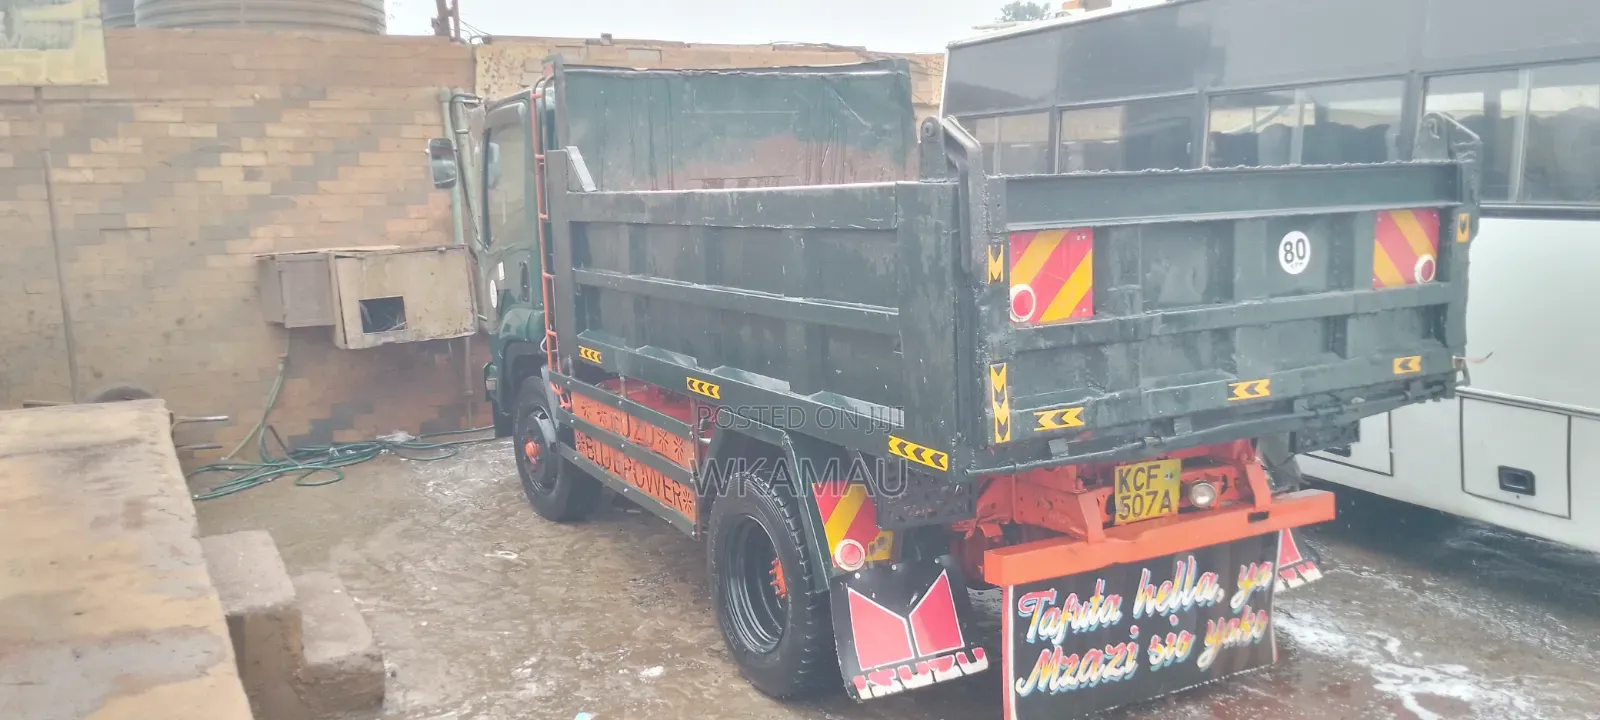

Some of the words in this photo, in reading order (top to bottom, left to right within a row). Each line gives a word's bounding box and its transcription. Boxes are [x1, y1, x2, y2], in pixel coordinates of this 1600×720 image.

[1283, 237, 1307, 264] 80
[622, 454, 684, 512] POWER
[1118, 463, 1161, 494] KCF
[1118, 489, 1173, 520] 507A
[1017, 587, 1123, 645] Tafuta
[1229, 560, 1274, 613] ya
[852, 646, 989, 701] ISUZU
[1015, 624, 1140, 697] Mzazi
[1148, 613, 1197, 671] sio
[1196, 604, 1269, 672] yako
